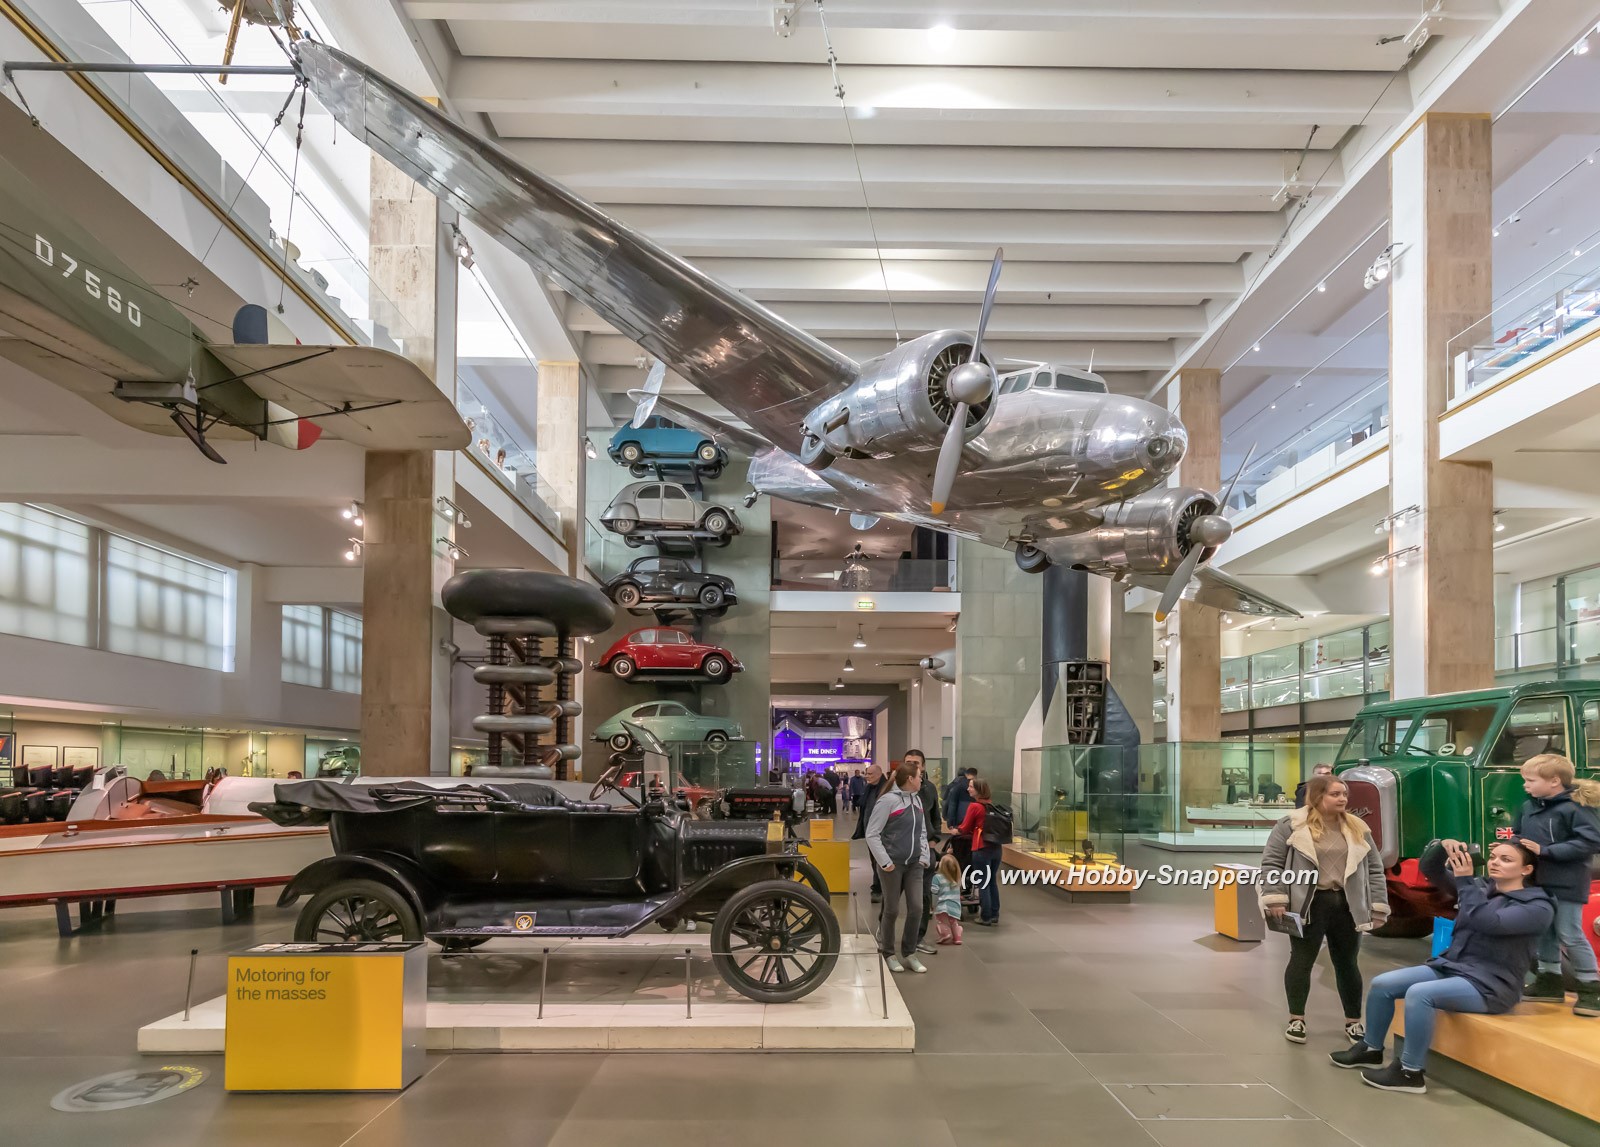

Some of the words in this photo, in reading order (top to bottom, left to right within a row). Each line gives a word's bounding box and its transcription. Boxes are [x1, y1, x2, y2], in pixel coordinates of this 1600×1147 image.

[35, 234, 141, 327] D7560
[236, 968, 305, 985] Motoring
[310, 968, 331, 982] for
[237, 987, 261, 1000] the
[266, 989, 326, 1001] masses
